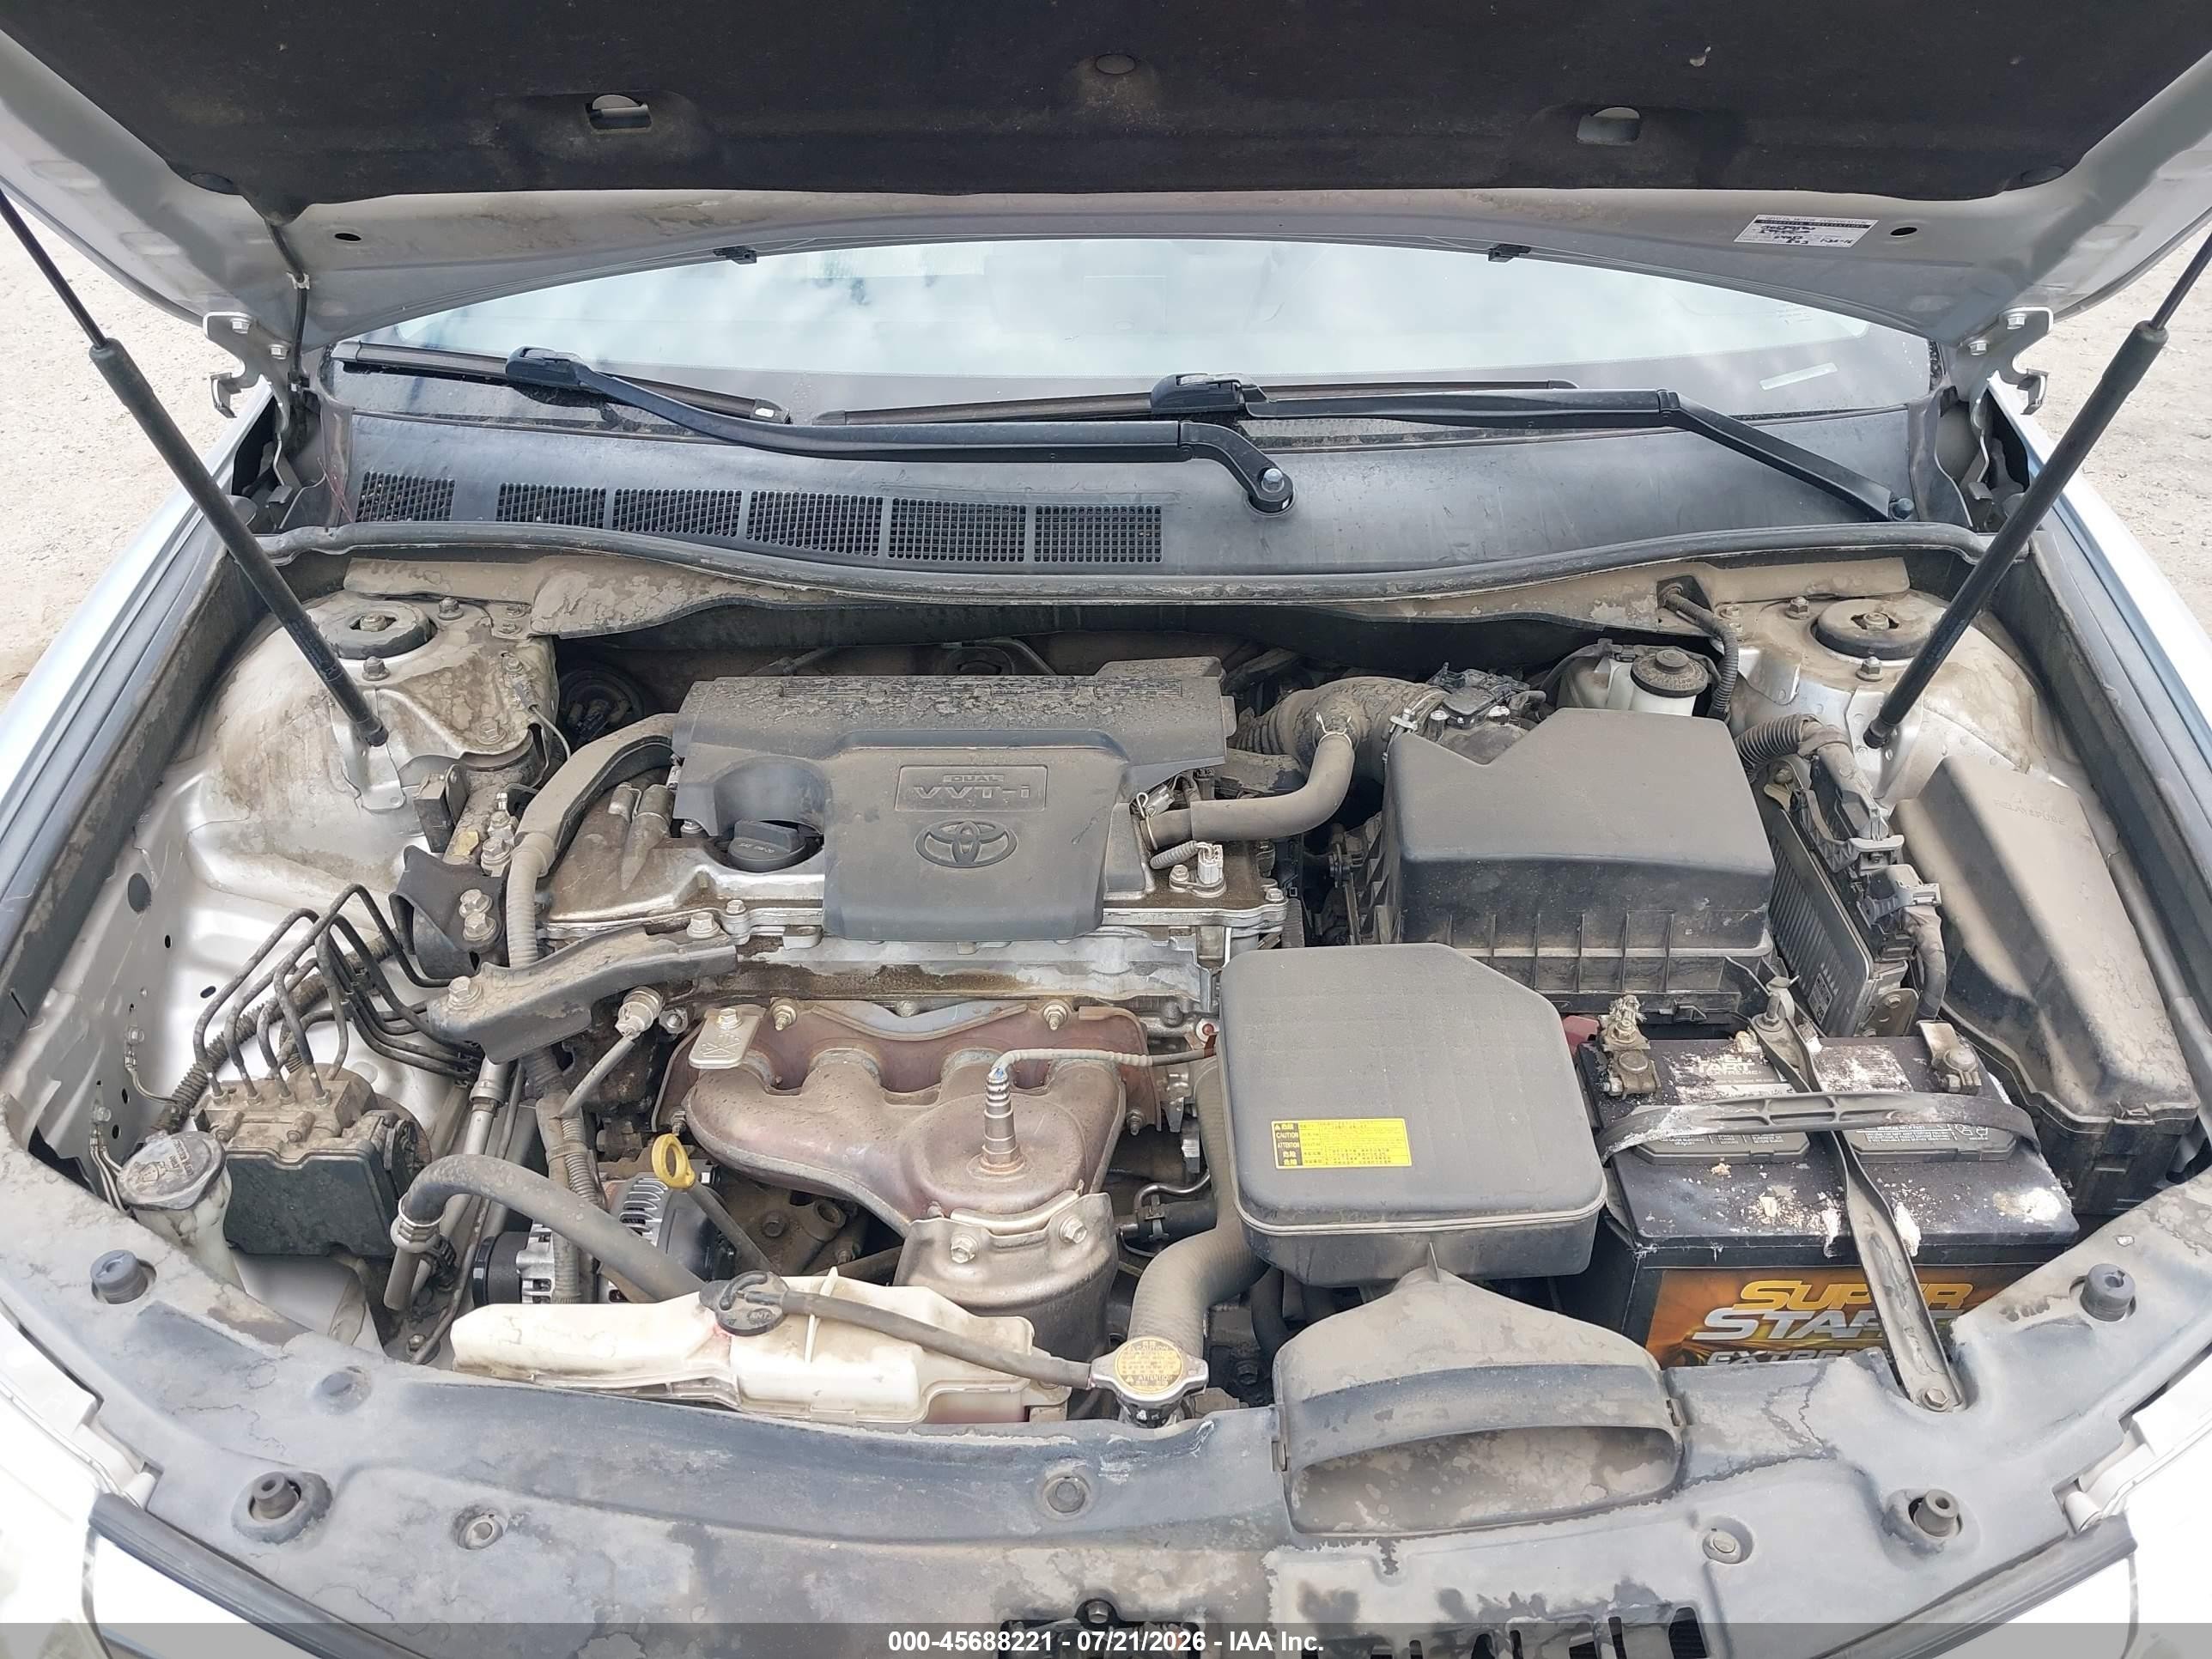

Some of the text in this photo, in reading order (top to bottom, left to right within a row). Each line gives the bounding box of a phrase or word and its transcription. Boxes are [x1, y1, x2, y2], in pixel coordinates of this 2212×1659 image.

[913, 784, 1030, 799] VVT-i
[1733, 1280, 1973, 1310] SUPR
[1692, 1307, 1965, 1340] STAR
